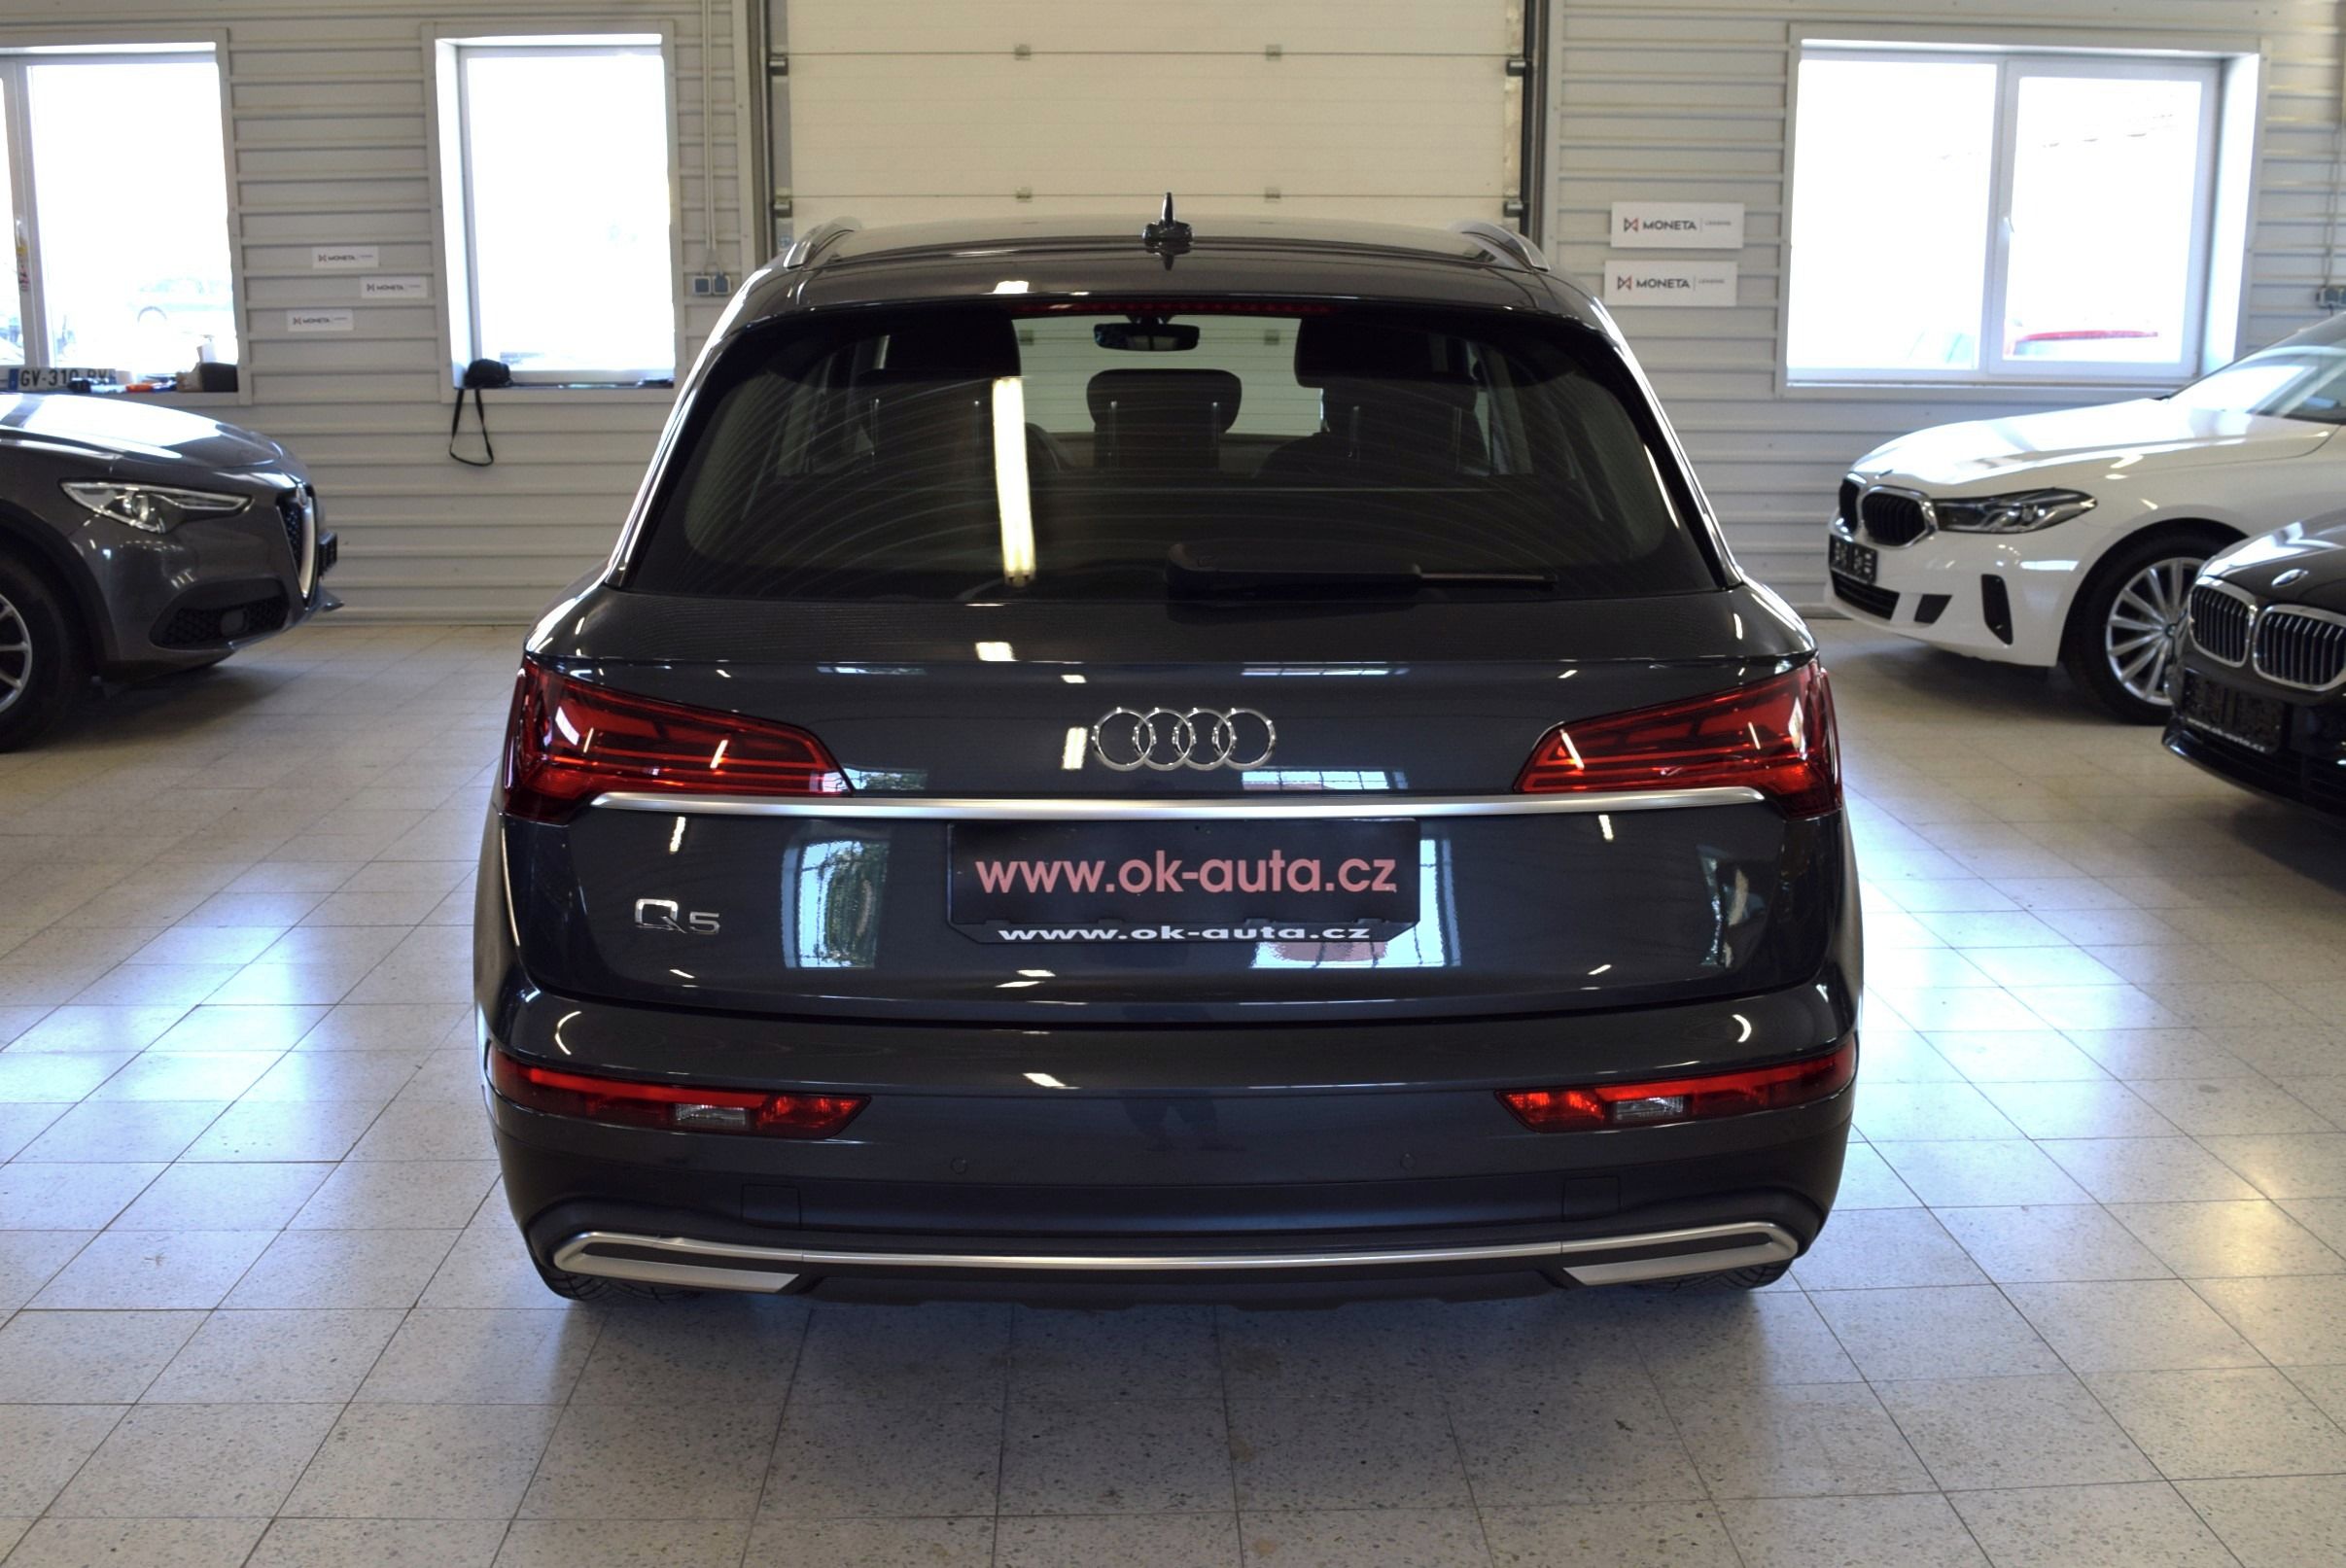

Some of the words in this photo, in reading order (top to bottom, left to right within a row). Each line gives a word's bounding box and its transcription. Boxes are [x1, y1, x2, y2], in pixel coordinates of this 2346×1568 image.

[1642, 221, 1698, 230] MONETA
[1636, 278, 1691, 289] MONETA
[975, 849, 1397, 894] www.ok-auta.cz
[634, 898, 721, 935] Q5
[998, 925, 1371, 941] www.ok-auta.cz
